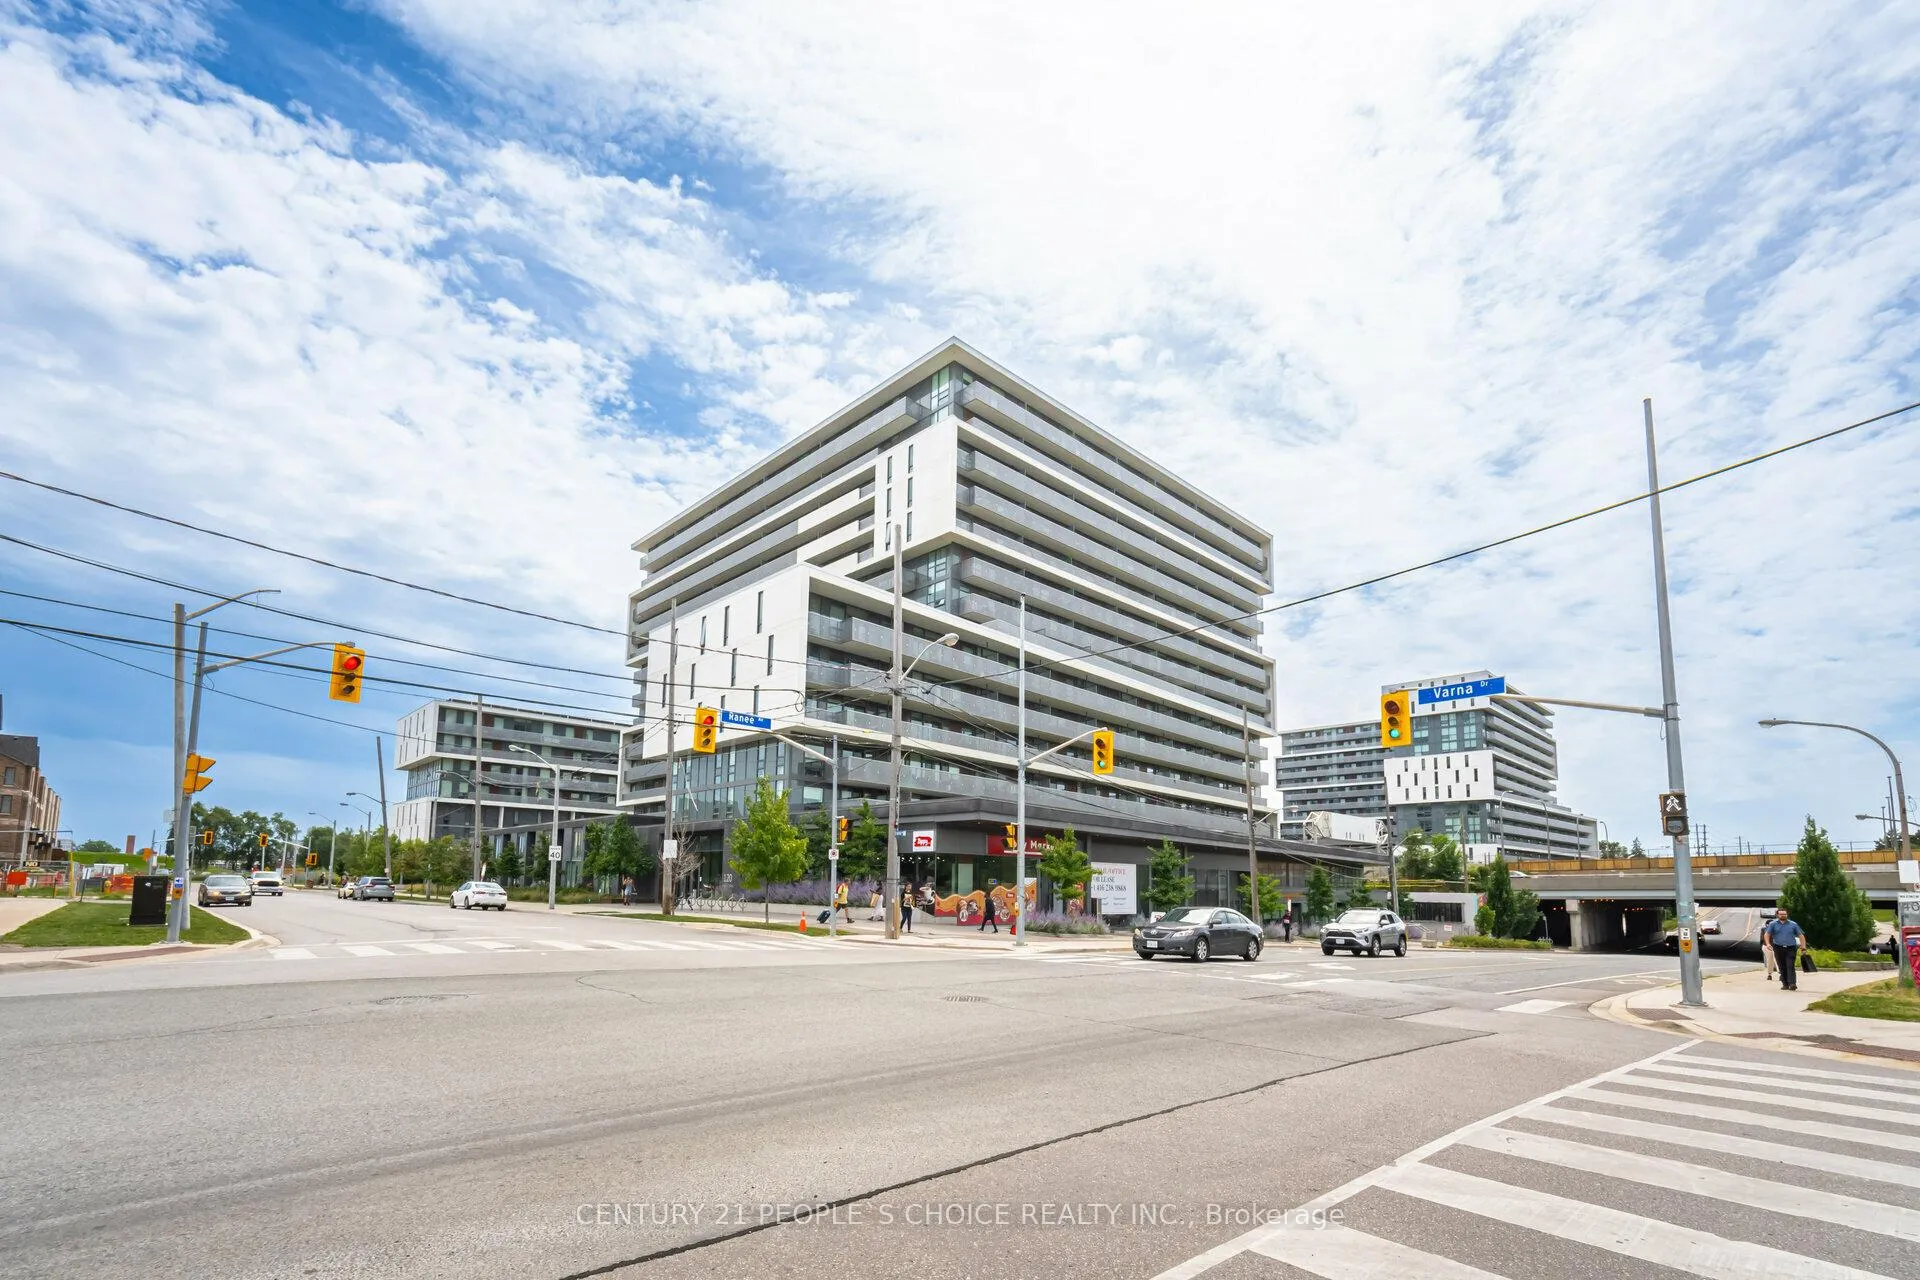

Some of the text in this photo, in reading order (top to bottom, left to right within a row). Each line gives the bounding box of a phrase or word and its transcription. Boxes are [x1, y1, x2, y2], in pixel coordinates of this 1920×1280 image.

[1433, 685, 1473, 699] Varna
[728, 711, 755, 725] Ranee
[550, 851, 561, 859] 40
